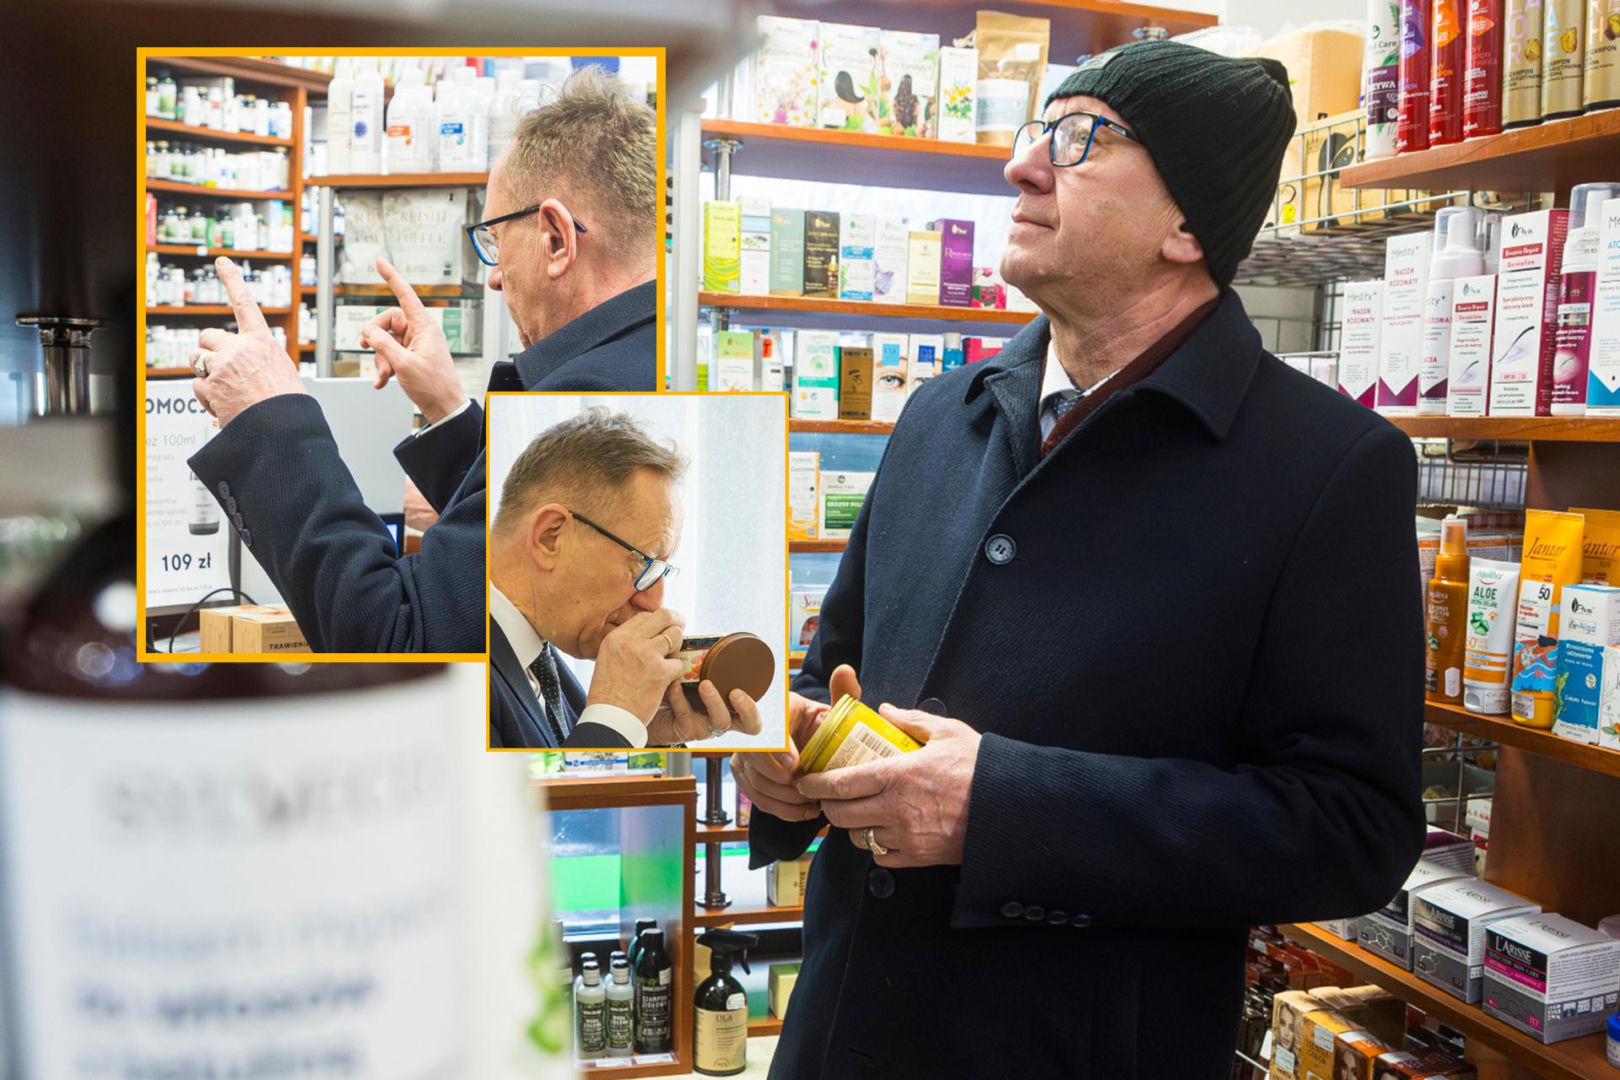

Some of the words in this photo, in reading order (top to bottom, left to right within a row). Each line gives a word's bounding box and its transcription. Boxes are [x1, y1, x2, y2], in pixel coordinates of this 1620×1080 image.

[1524, 536, 1568, 558] Jantar
[162, 553, 192, 572] 109
[198, 552, 212, 569] zł
[1473, 586, 1498, 600] ALOE
[1537, 587, 1551, 600] 50
